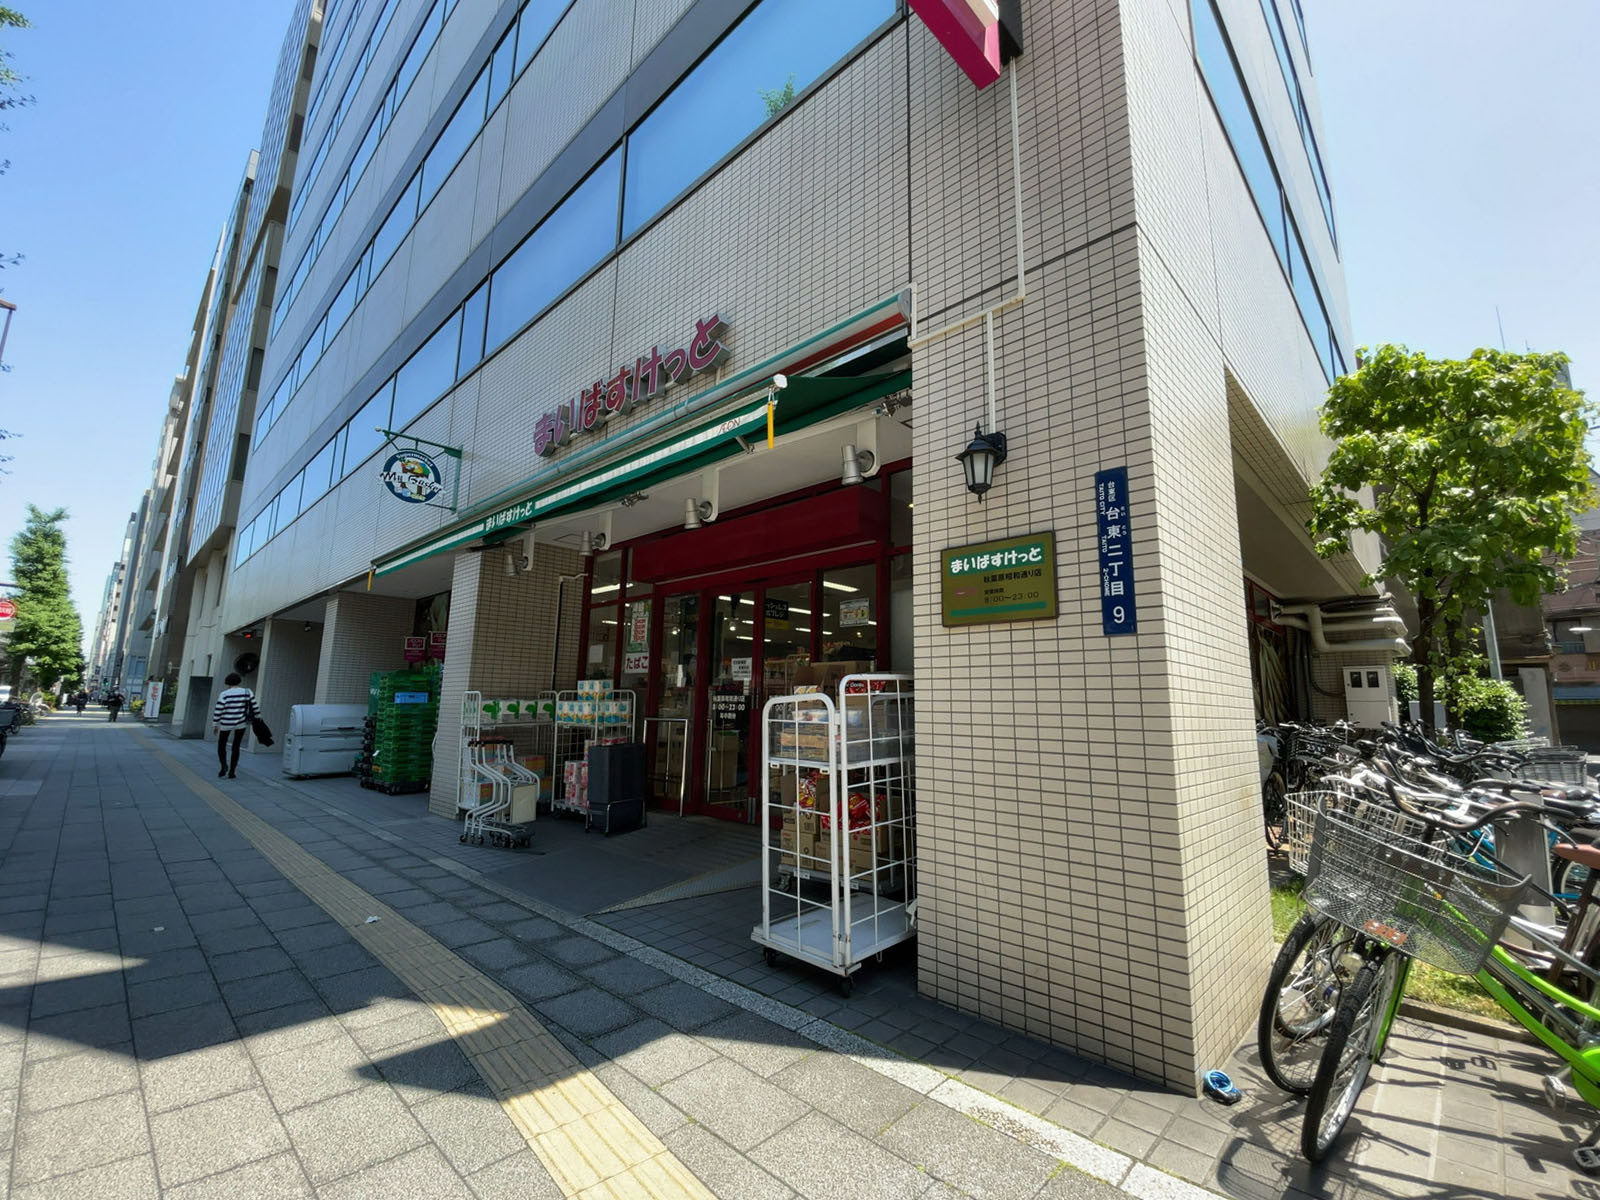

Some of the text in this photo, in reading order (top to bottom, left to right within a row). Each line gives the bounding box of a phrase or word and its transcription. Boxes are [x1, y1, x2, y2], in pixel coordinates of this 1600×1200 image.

[534, 313, 727, 456] まいばすけっと
[380, 472, 403, 483] My
[1108, 481, 1116, 502] 台東区
[485, 501, 533, 531] まいばすけっと
[951, 547, 1042, 573] まいばすけっと
[1106, 507, 1125, 623] 台東二丁目 9
[626, 656, 649, 669] たばこ
